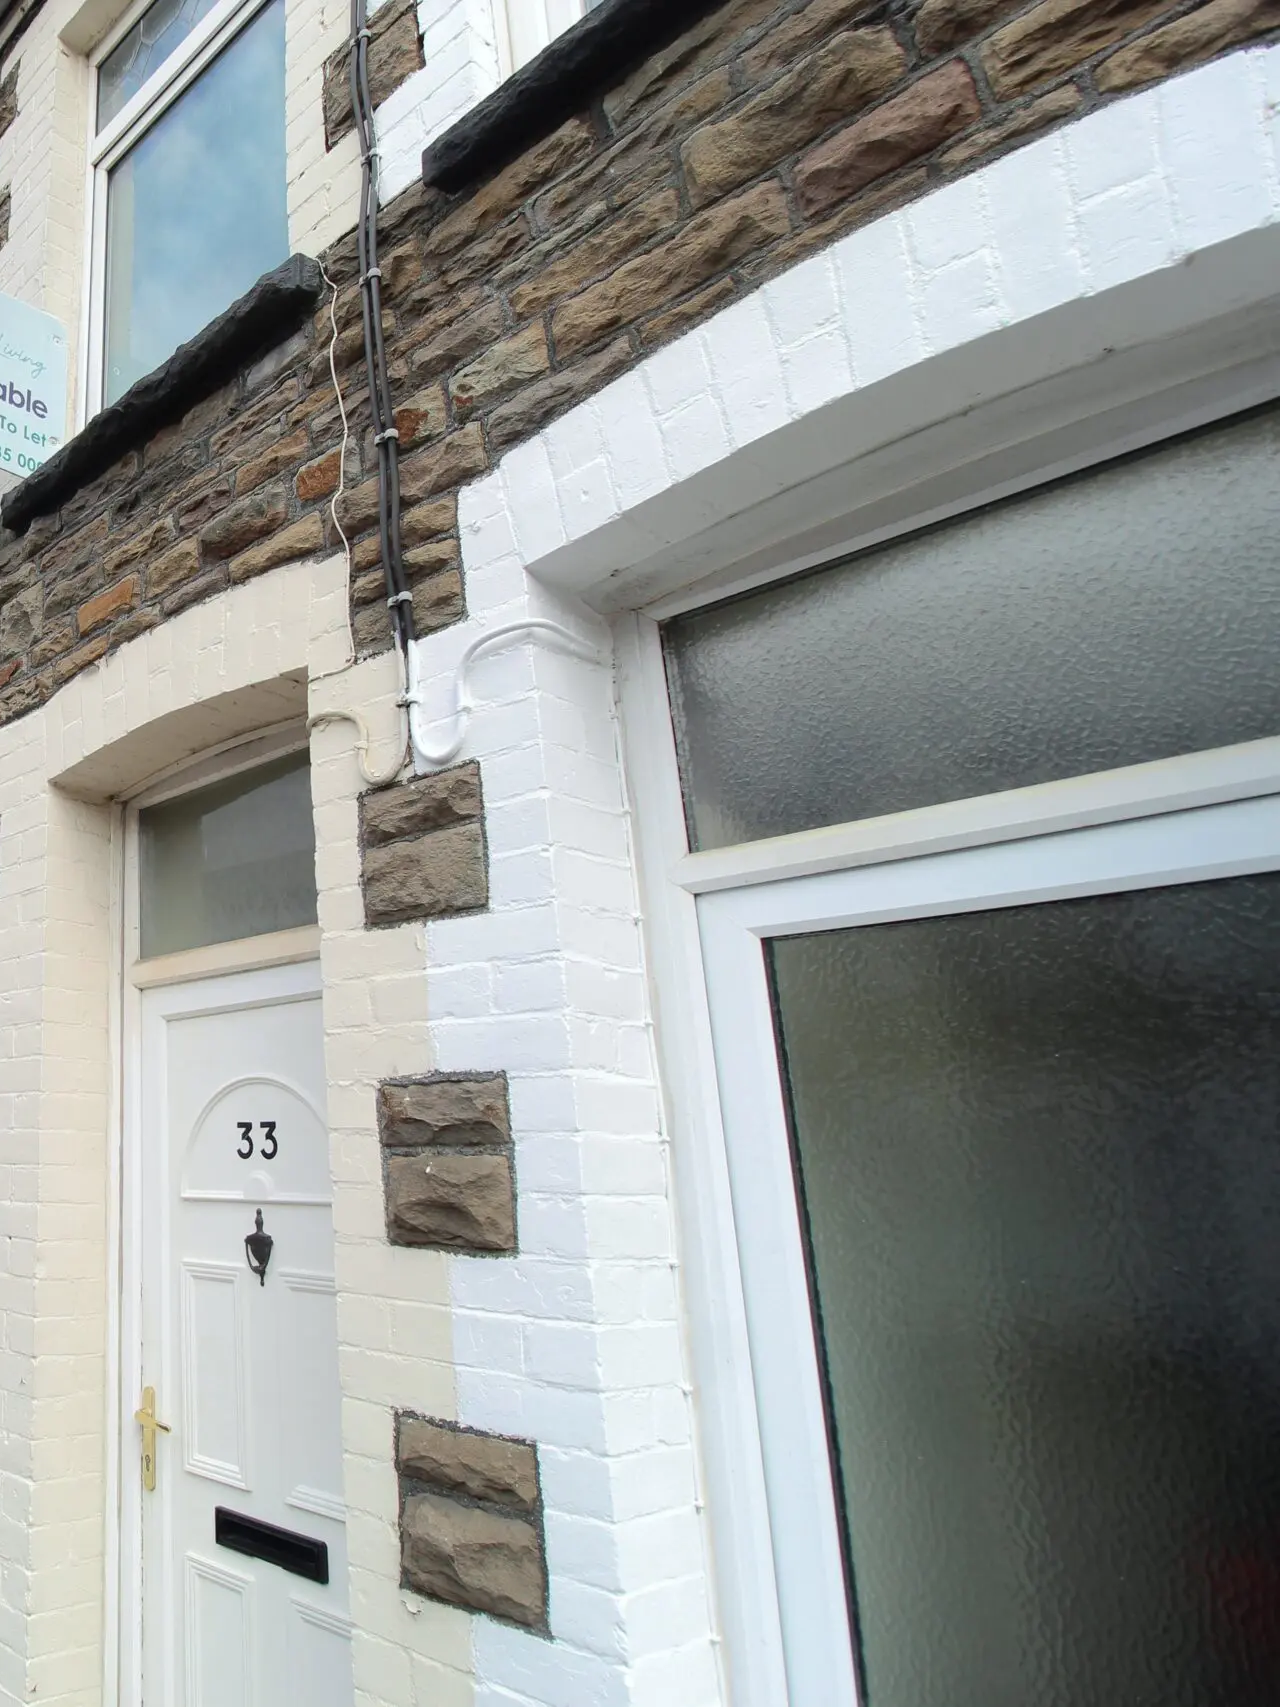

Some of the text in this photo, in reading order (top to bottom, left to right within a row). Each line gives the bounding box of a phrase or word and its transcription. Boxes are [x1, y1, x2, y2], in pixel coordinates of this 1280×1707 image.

[0, 414, 47, 448] To Let
[237, 1121, 278, 1160] 33
